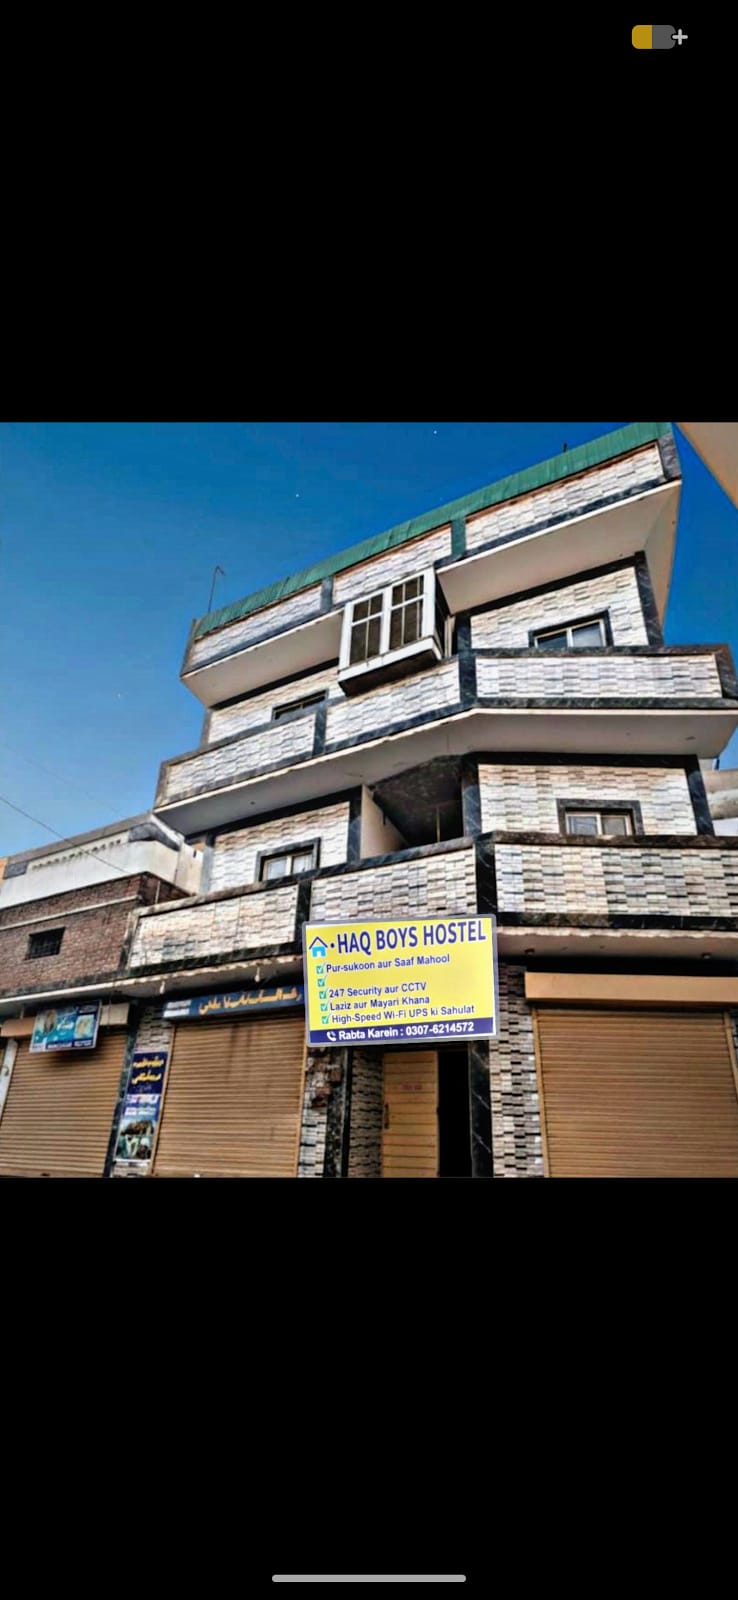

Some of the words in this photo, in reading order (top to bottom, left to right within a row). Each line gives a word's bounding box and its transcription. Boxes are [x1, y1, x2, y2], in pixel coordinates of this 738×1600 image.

[337, 931, 372, 955] HAQ
[377, 926, 418, 950] BOYS
[423, 921, 486, 945] HOSTEL
[326, 959, 375, 973] Pur-sukoon
[377, 960, 391, 969] aur
[394, 957, 413, 967] Saaf
[417, 954, 450, 965] Mahool
[329, 989, 345, 998] 247
[347, 985, 381, 997] Security
[401, 982, 427, 992] CCTV
[330, 1002, 351, 1011] Laziz
[354, 1001, 367, 1009] aur
[370, 997, 400, 1009] Mayari
[402, 996, 430, 1005] Khana
[332, 1012, 381, 1024] High-Speed
[384, 1010, 407, 1019] Wi-Fi
[409, 1008, 428, 1017] UPS
[431, 1006, 439, 1015] ki
[441, 1004, 474, 1015] Sahulat
[338, 1030, 366, 1040] Rabta
[406, 1021, 474, 1034] 0307-6214572
